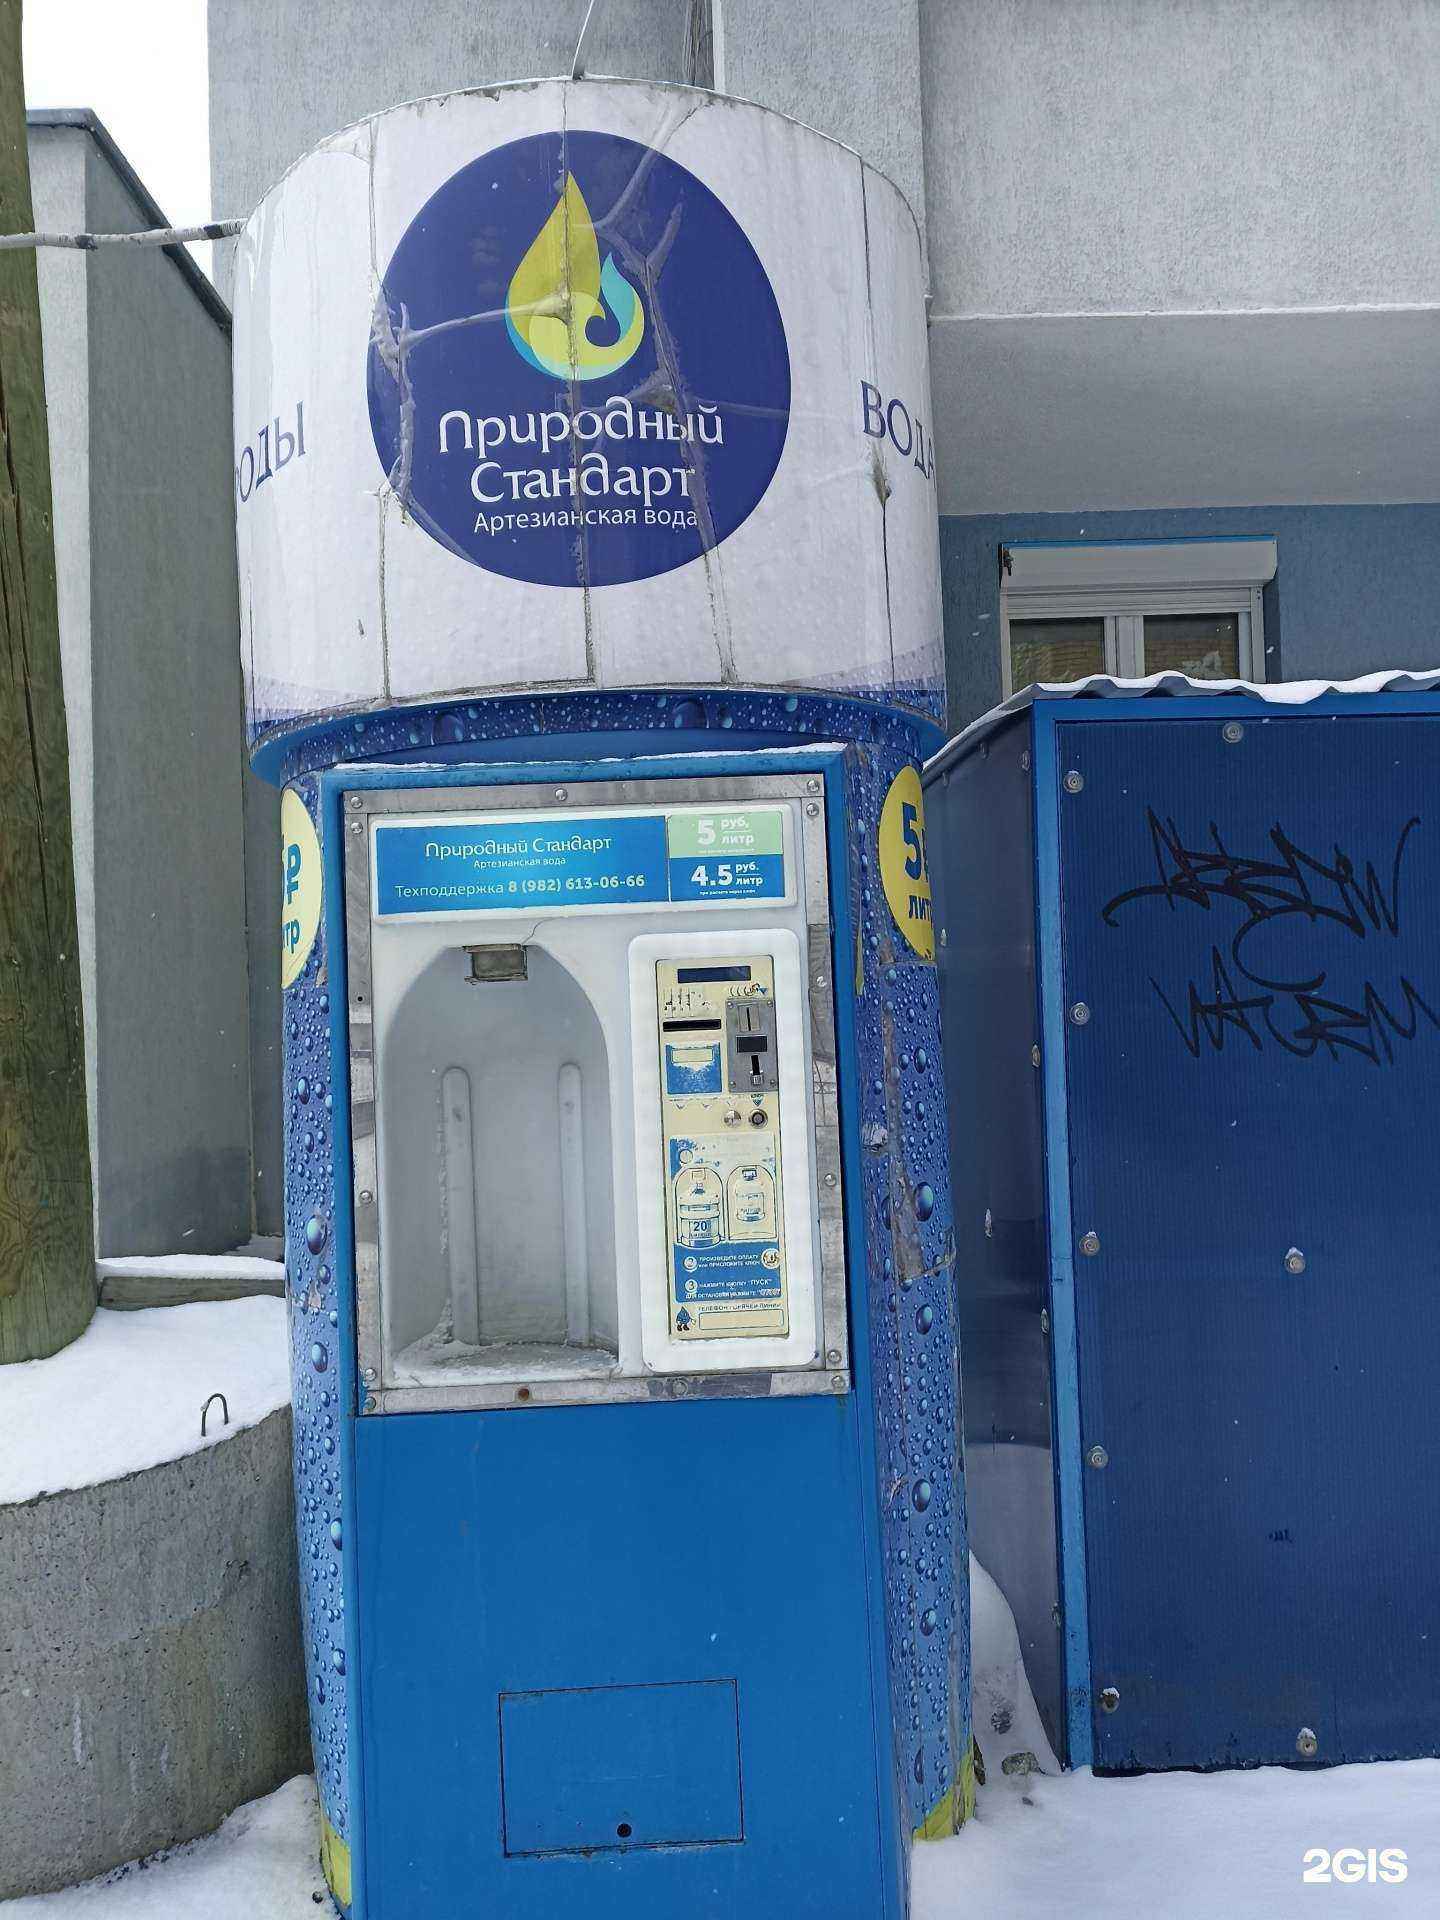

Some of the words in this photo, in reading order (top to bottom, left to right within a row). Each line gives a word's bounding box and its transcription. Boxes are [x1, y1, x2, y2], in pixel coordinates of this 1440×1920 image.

[439, 395, 724, 459] Природный
[470, 452, 697, 507] Стандарт
[473, 508, 638, 537] Артезианская
[643, 507, 698, 527] вода
[697, 819, 716, 845] 5
[721, 834, 755, 846] литр
[425, 839, 528, 860] Природный
[532, 835, 612, 854] Стандарт
[473, 857, 541, 870] Артезианская
[543, 857, 567, 866] вода
[690, 864, 733, 886] 4.5
[735, 861, 760, 873] руб.
[394, 884, 504, 898] Техподдержка
[508, 880, 518, 893] 8
[521, 878, 561, 894] (982)
[565, 874, 646, 890] 613-06-66
[735, 876, 763, 887] литр
[693, 1220, 708, 1232] 20
